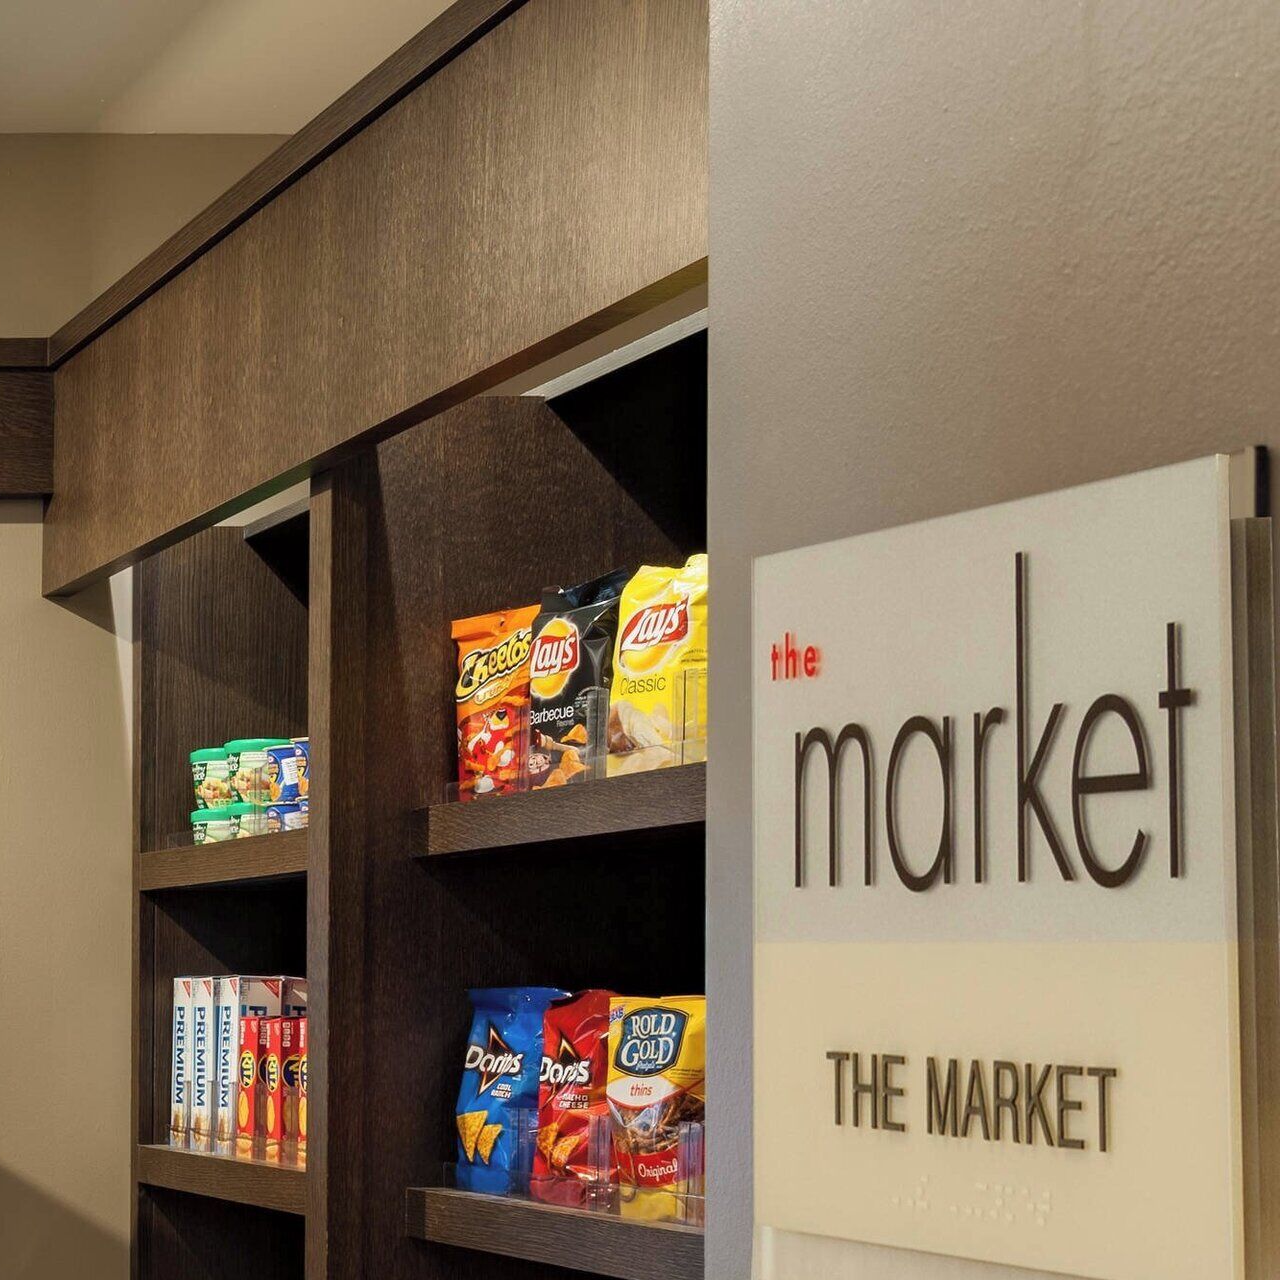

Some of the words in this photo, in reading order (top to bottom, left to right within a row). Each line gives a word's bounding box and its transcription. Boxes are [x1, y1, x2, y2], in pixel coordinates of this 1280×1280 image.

[621, 603, 686, 651] Lay's
[456, 631, 532, 697] Cheetos
[530, 634, 576, 678] Lay's
[770, 632, 820, 680] the
[620, 674, 666, 696] Classic
[794, 551, 1197, 892] market
[631, 1014, 676, 1039] ROLD
[173, 1006, 185, 1104] PREMIUM
[197, 1006, 205, 1106] PREMIUM
[219, 1006, 231, 1107] PREMIUM
[465, 1045, 523, 1073] Doritos
[621, 1037, 674, 1067] GOLD
[630, 1083, 652, 1096] thins
[826, 1051, 907, 1135] THE
[926, 1057, 1118, 1153] MARKET
[638, 1161, 678, 1181] Original
